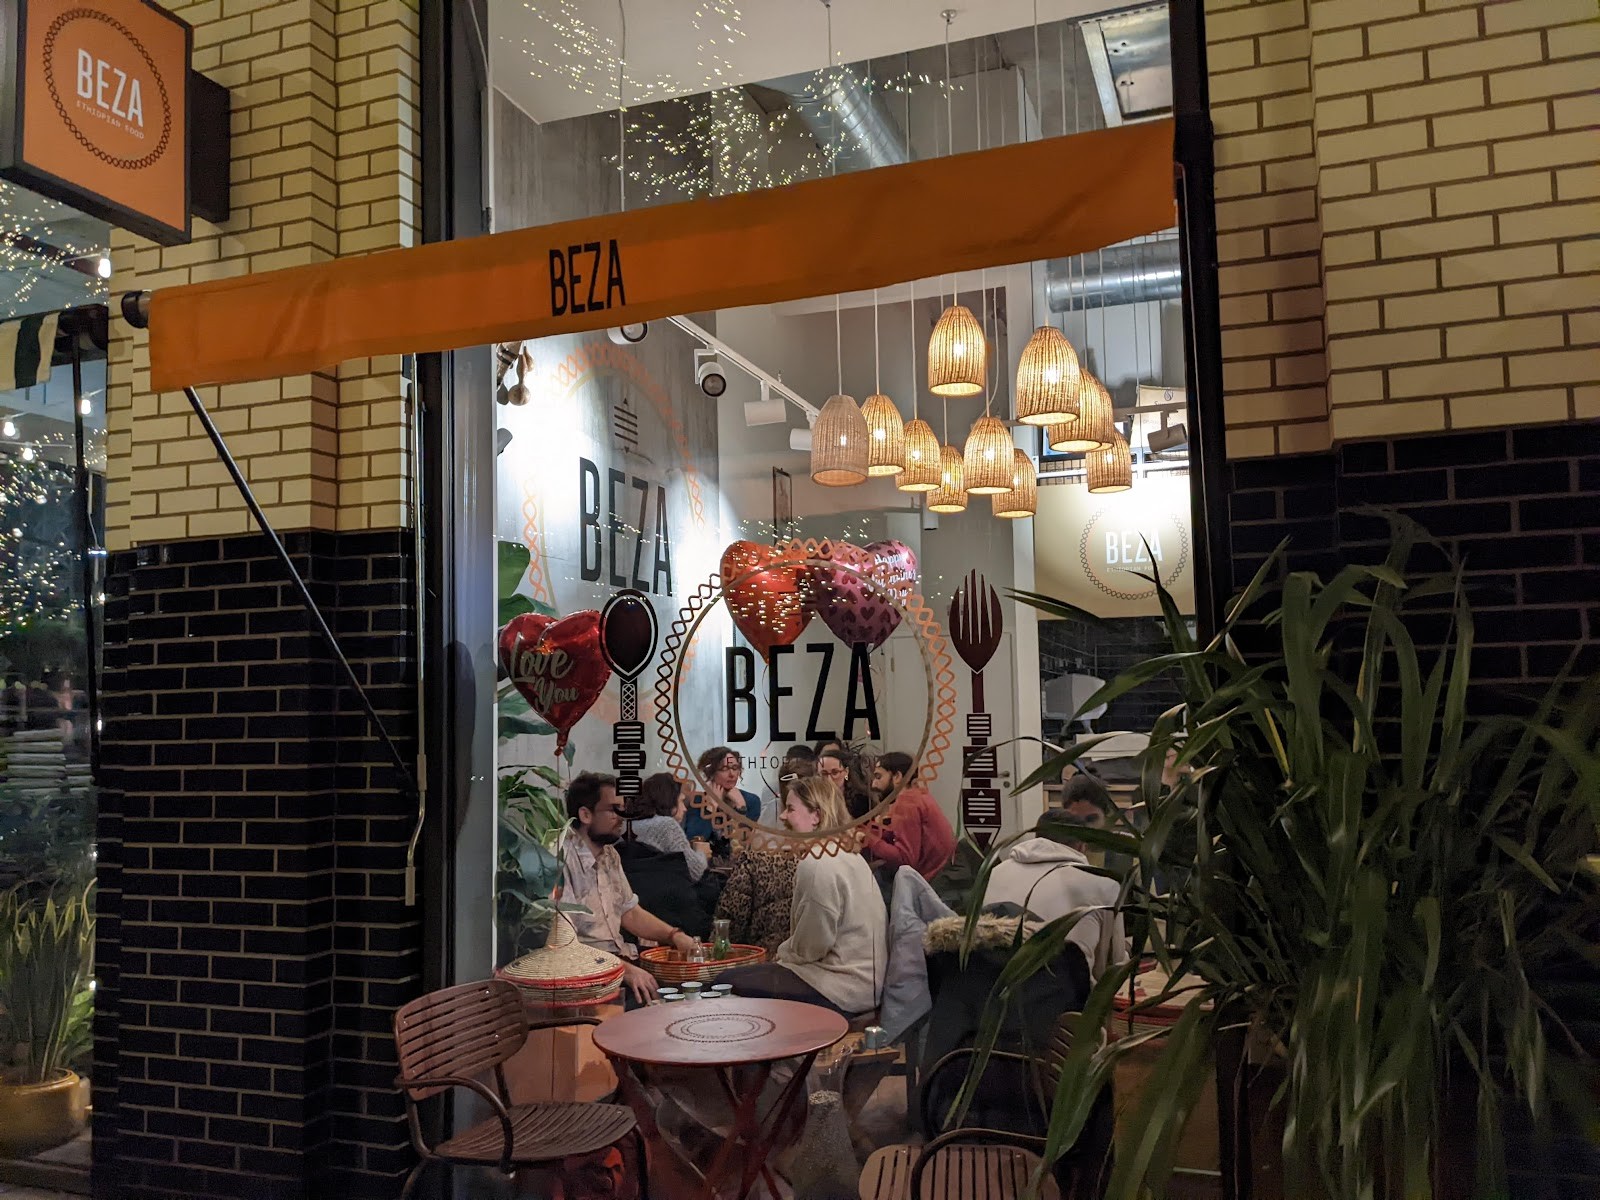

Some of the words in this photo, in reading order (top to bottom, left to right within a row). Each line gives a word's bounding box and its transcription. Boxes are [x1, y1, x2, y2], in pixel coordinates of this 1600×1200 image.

[77, 48, 144, 127] BEZA
[549, 239, 626, 317] BEZA
[579, 457, 673, 597] BEZA
[1105, 528, 1163, 565] BEZA
[510, 631, 574, 683] Love
[535, 676, 580, 716] You
[725, 641, 881, 743] BEZA
